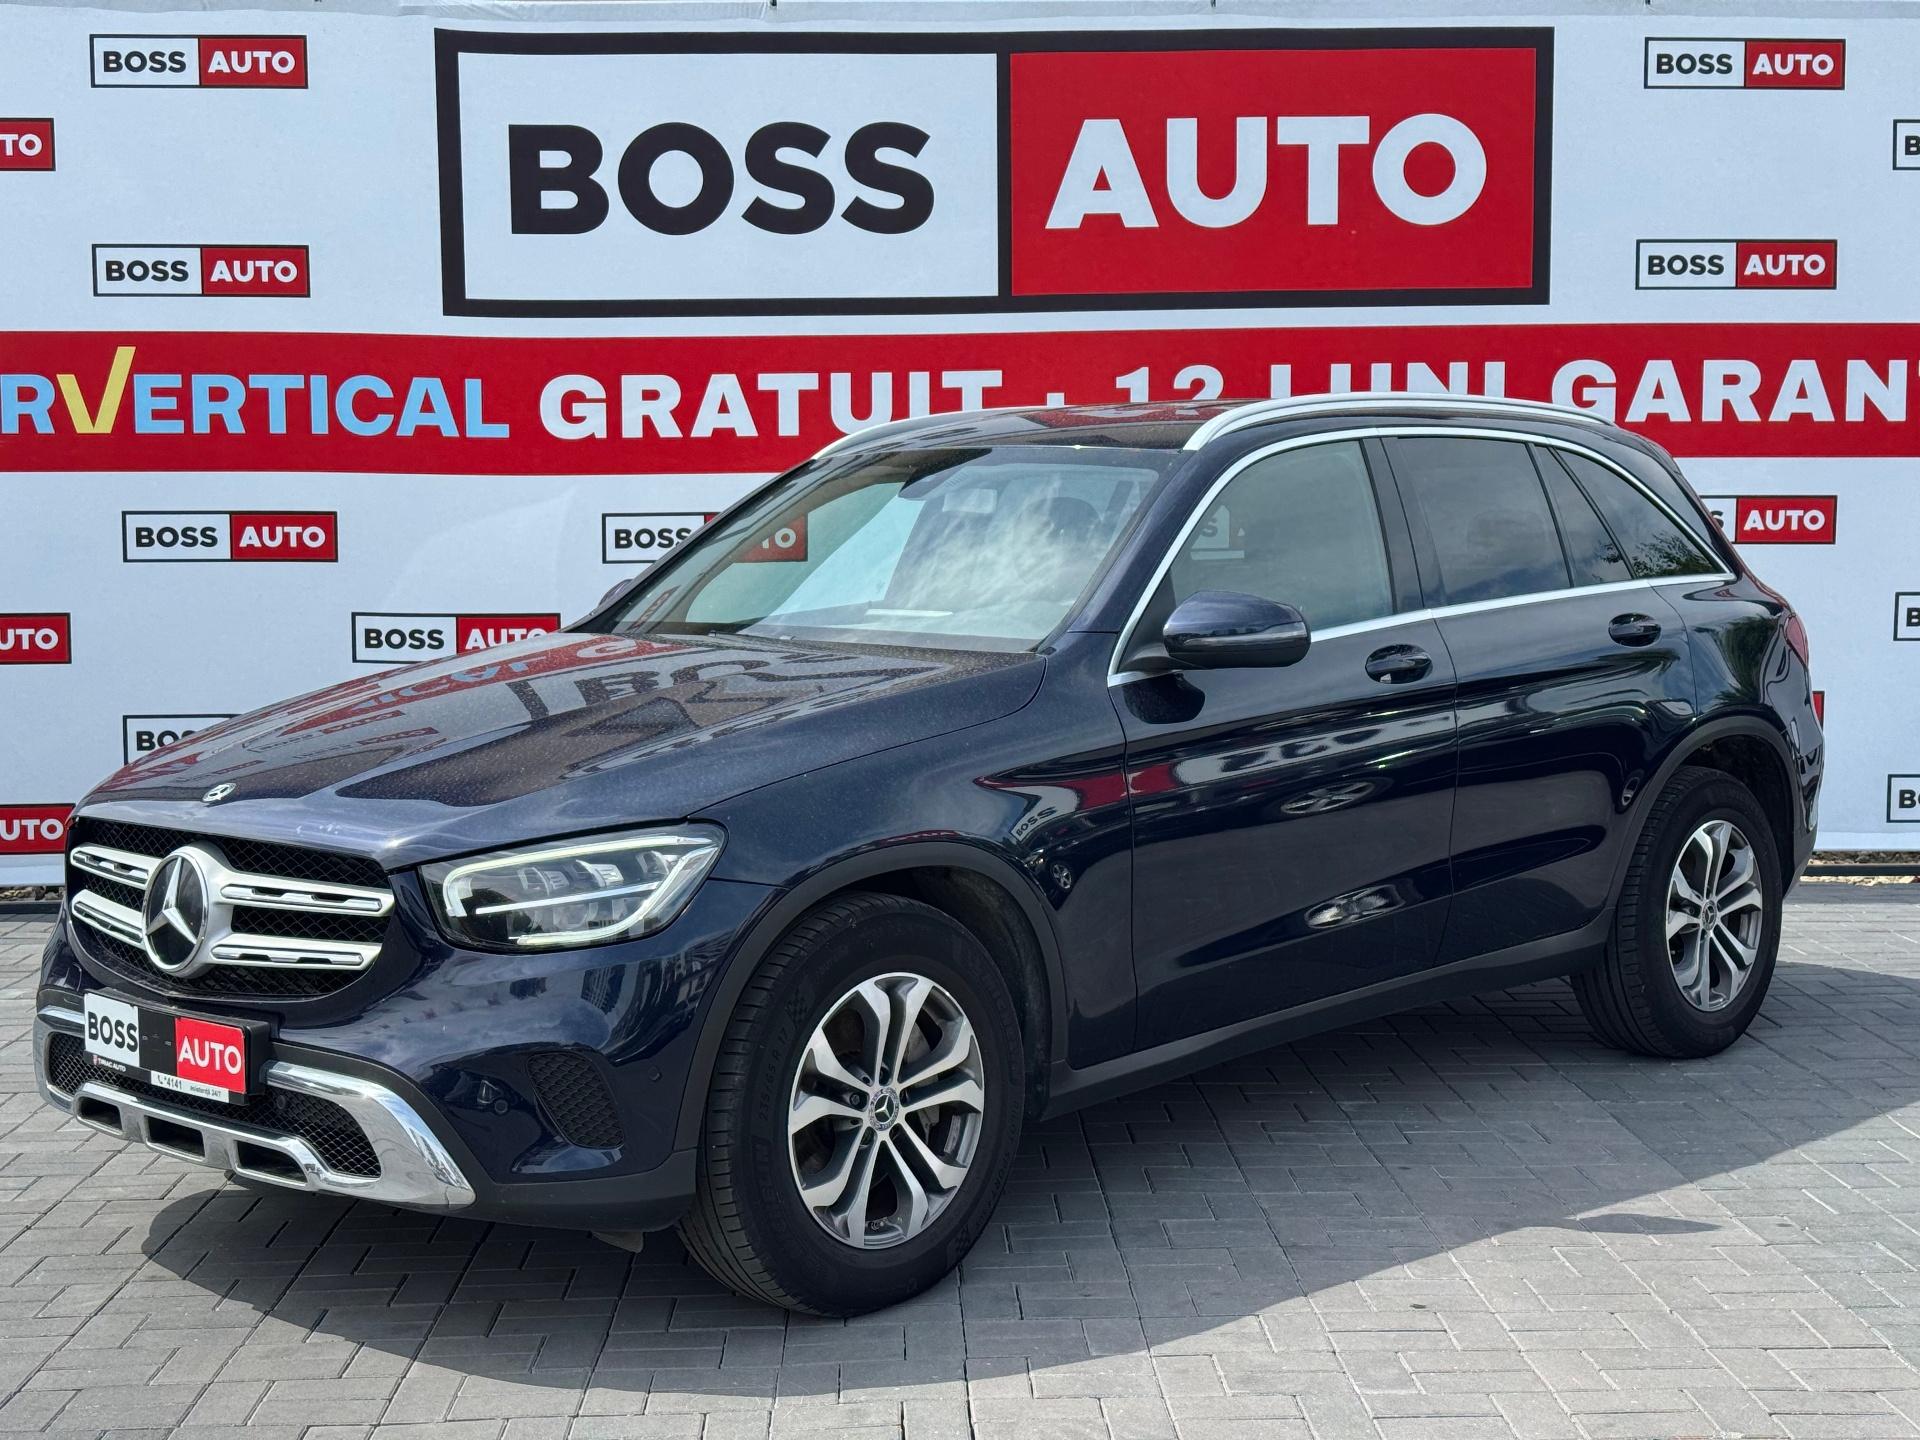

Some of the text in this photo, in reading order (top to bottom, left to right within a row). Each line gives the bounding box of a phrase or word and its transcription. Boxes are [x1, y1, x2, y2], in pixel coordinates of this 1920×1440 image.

[103, 50, 296, 74] BOSS AUTO
[1655, 53, 1834, 76] BOSS AUTO
[0, 133, 43, 156] TO
[508, 113, 1488, 236] BOSS AUTO
[105, 258, 298, 283] BOSS AUTO
[1647, 254, 1826, 276] BOSS AUTO
[0, 345, 510, 438] RVERTICAL
[539, 370, 1003, 440] GRATUIT
[1551, 359, 1920, 422] GARAN
[1743, 509, 1826, 531] AUTO
[135, 525, 326, 549] BOSS AUTO
[0, 628, 59, 651] UTO
[364, 628, 445, 650] BOSS
[136, 730, 195, 752] BO
[0, 818, 65, 841] UTO
[87, 1010, 241, 1074] BOSS AUTO
